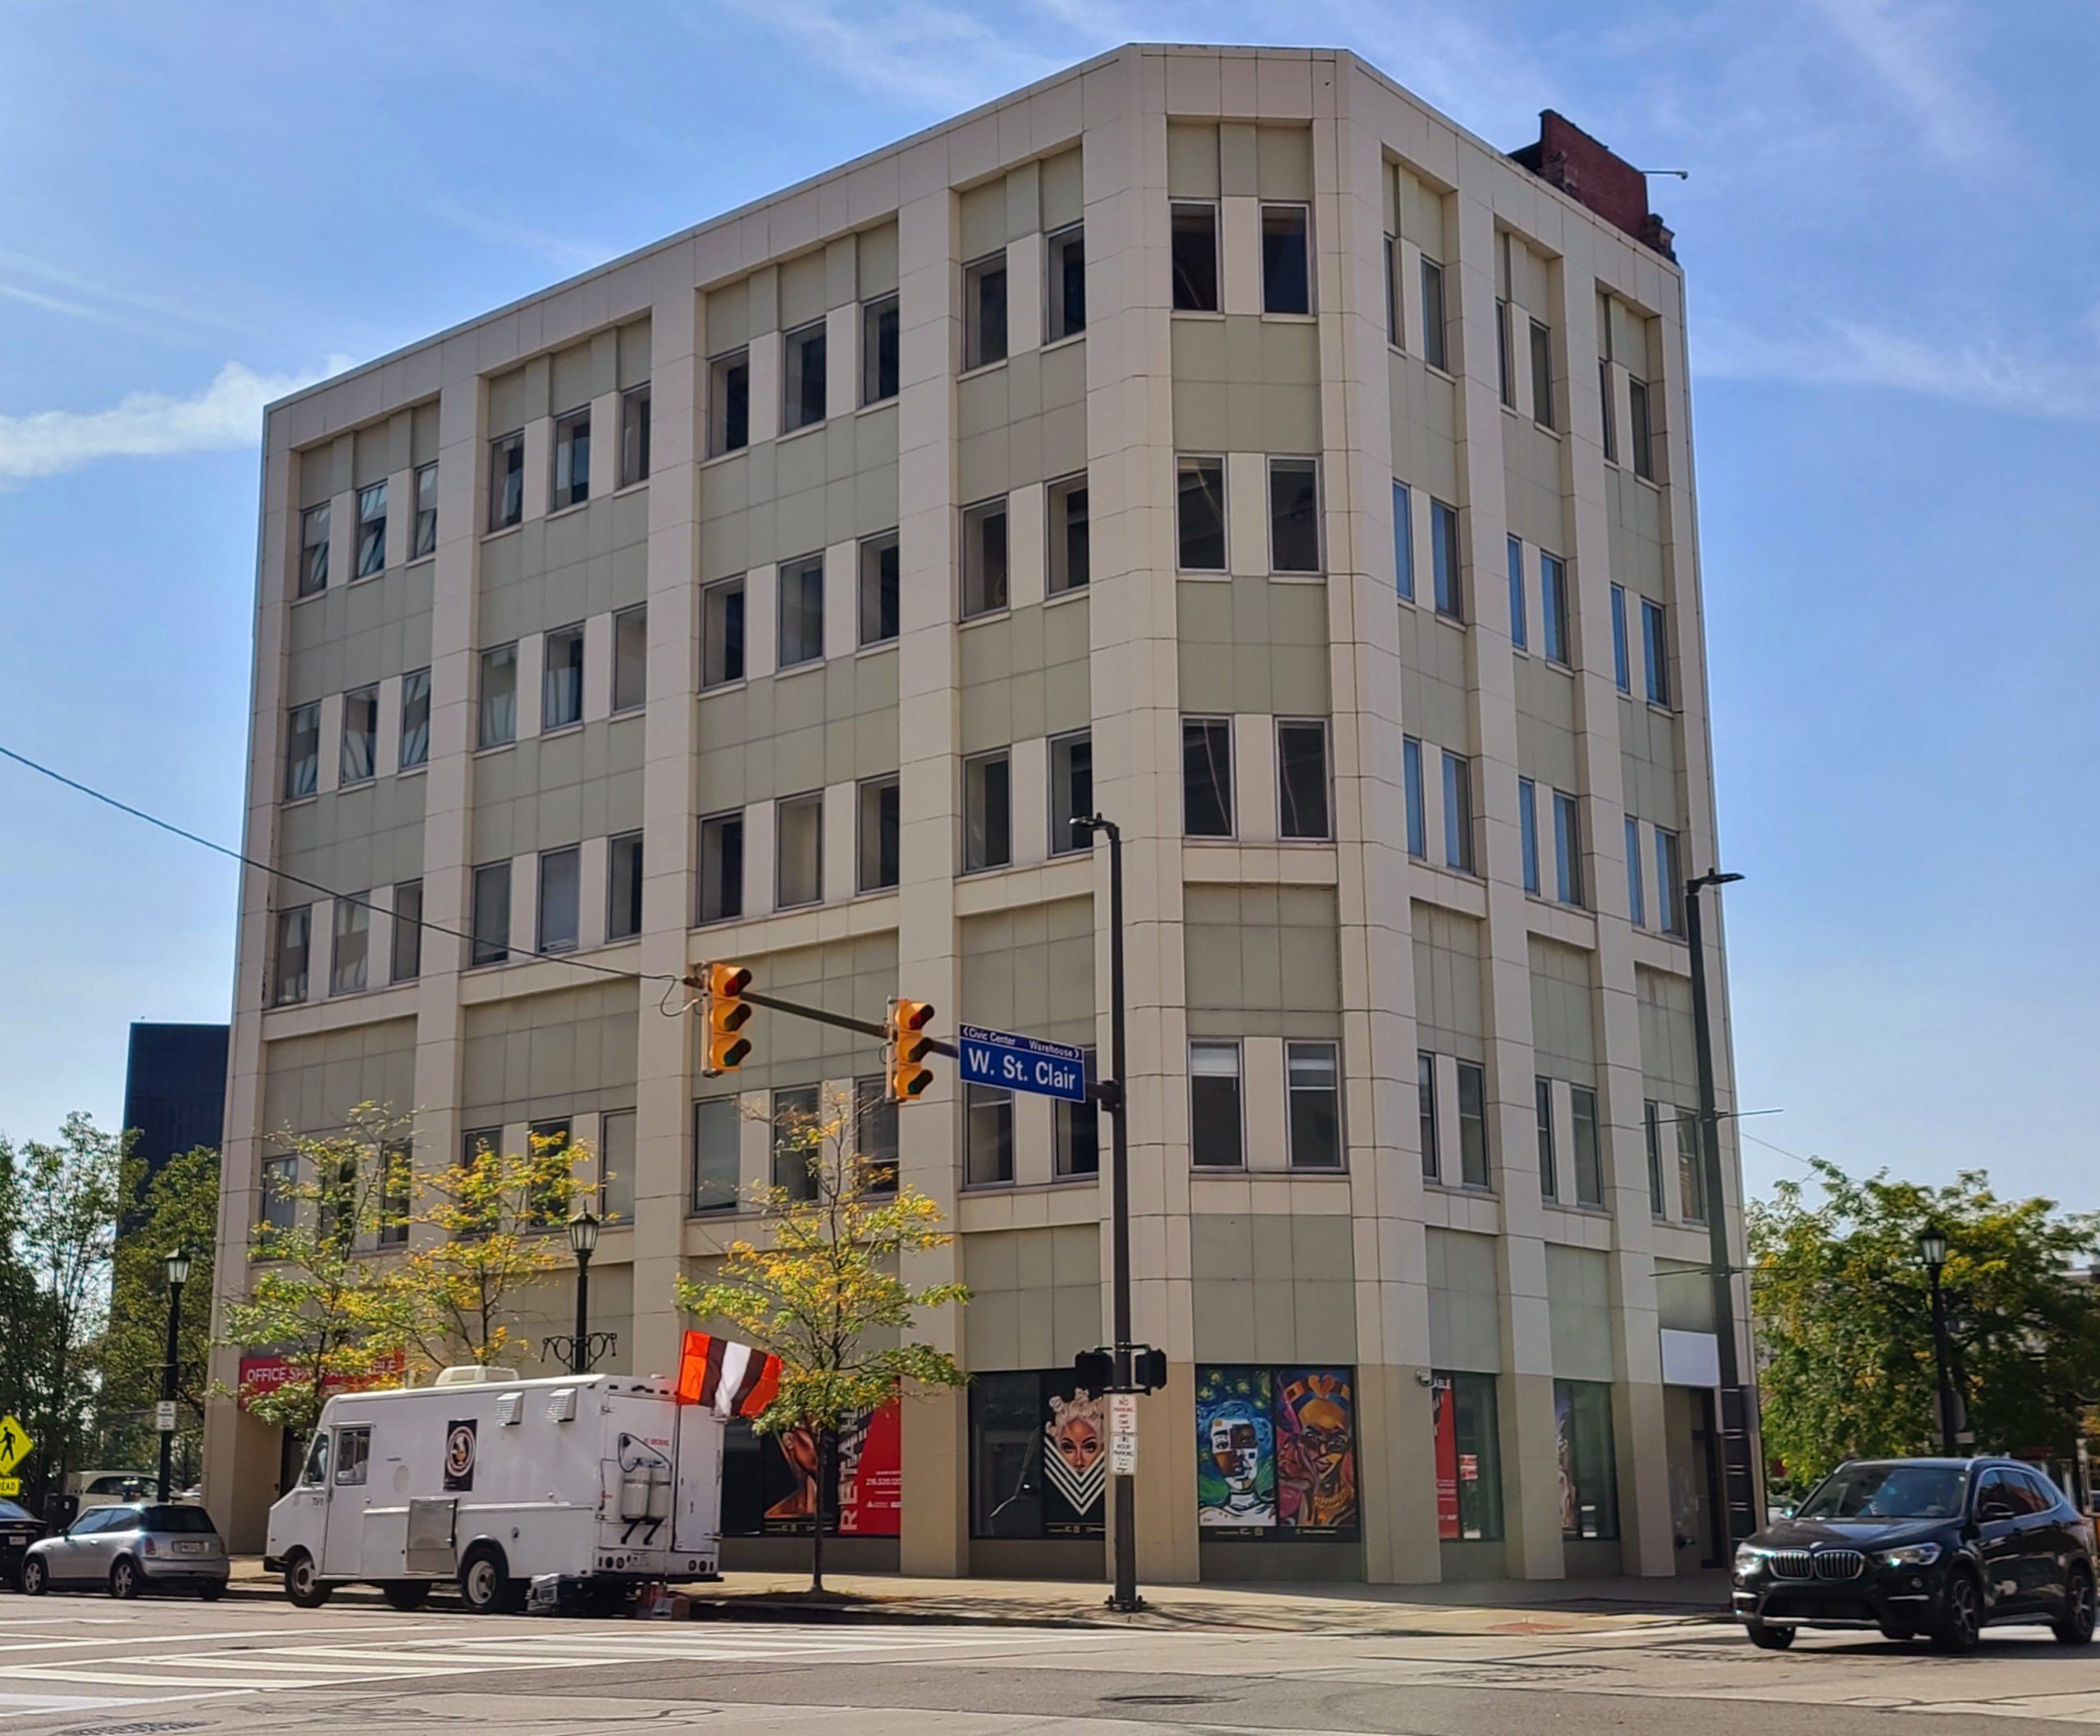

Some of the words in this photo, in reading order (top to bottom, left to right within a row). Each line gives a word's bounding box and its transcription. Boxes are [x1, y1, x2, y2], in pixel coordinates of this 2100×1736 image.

[969, 1027, 988, 1041] Civic
[989, 1031, 1016, 1046] Center
[1029, 1039, 1073, 1058] Warehouse
[968, 1047, 994, 1076] W.
[1002, 1054, 1028, 1082] St.
[1035, 1061, 1076, 1090] Clair
[246, 1366, 287, 1383] OFFICE
[0, 1482, 16, 1492] EAD
